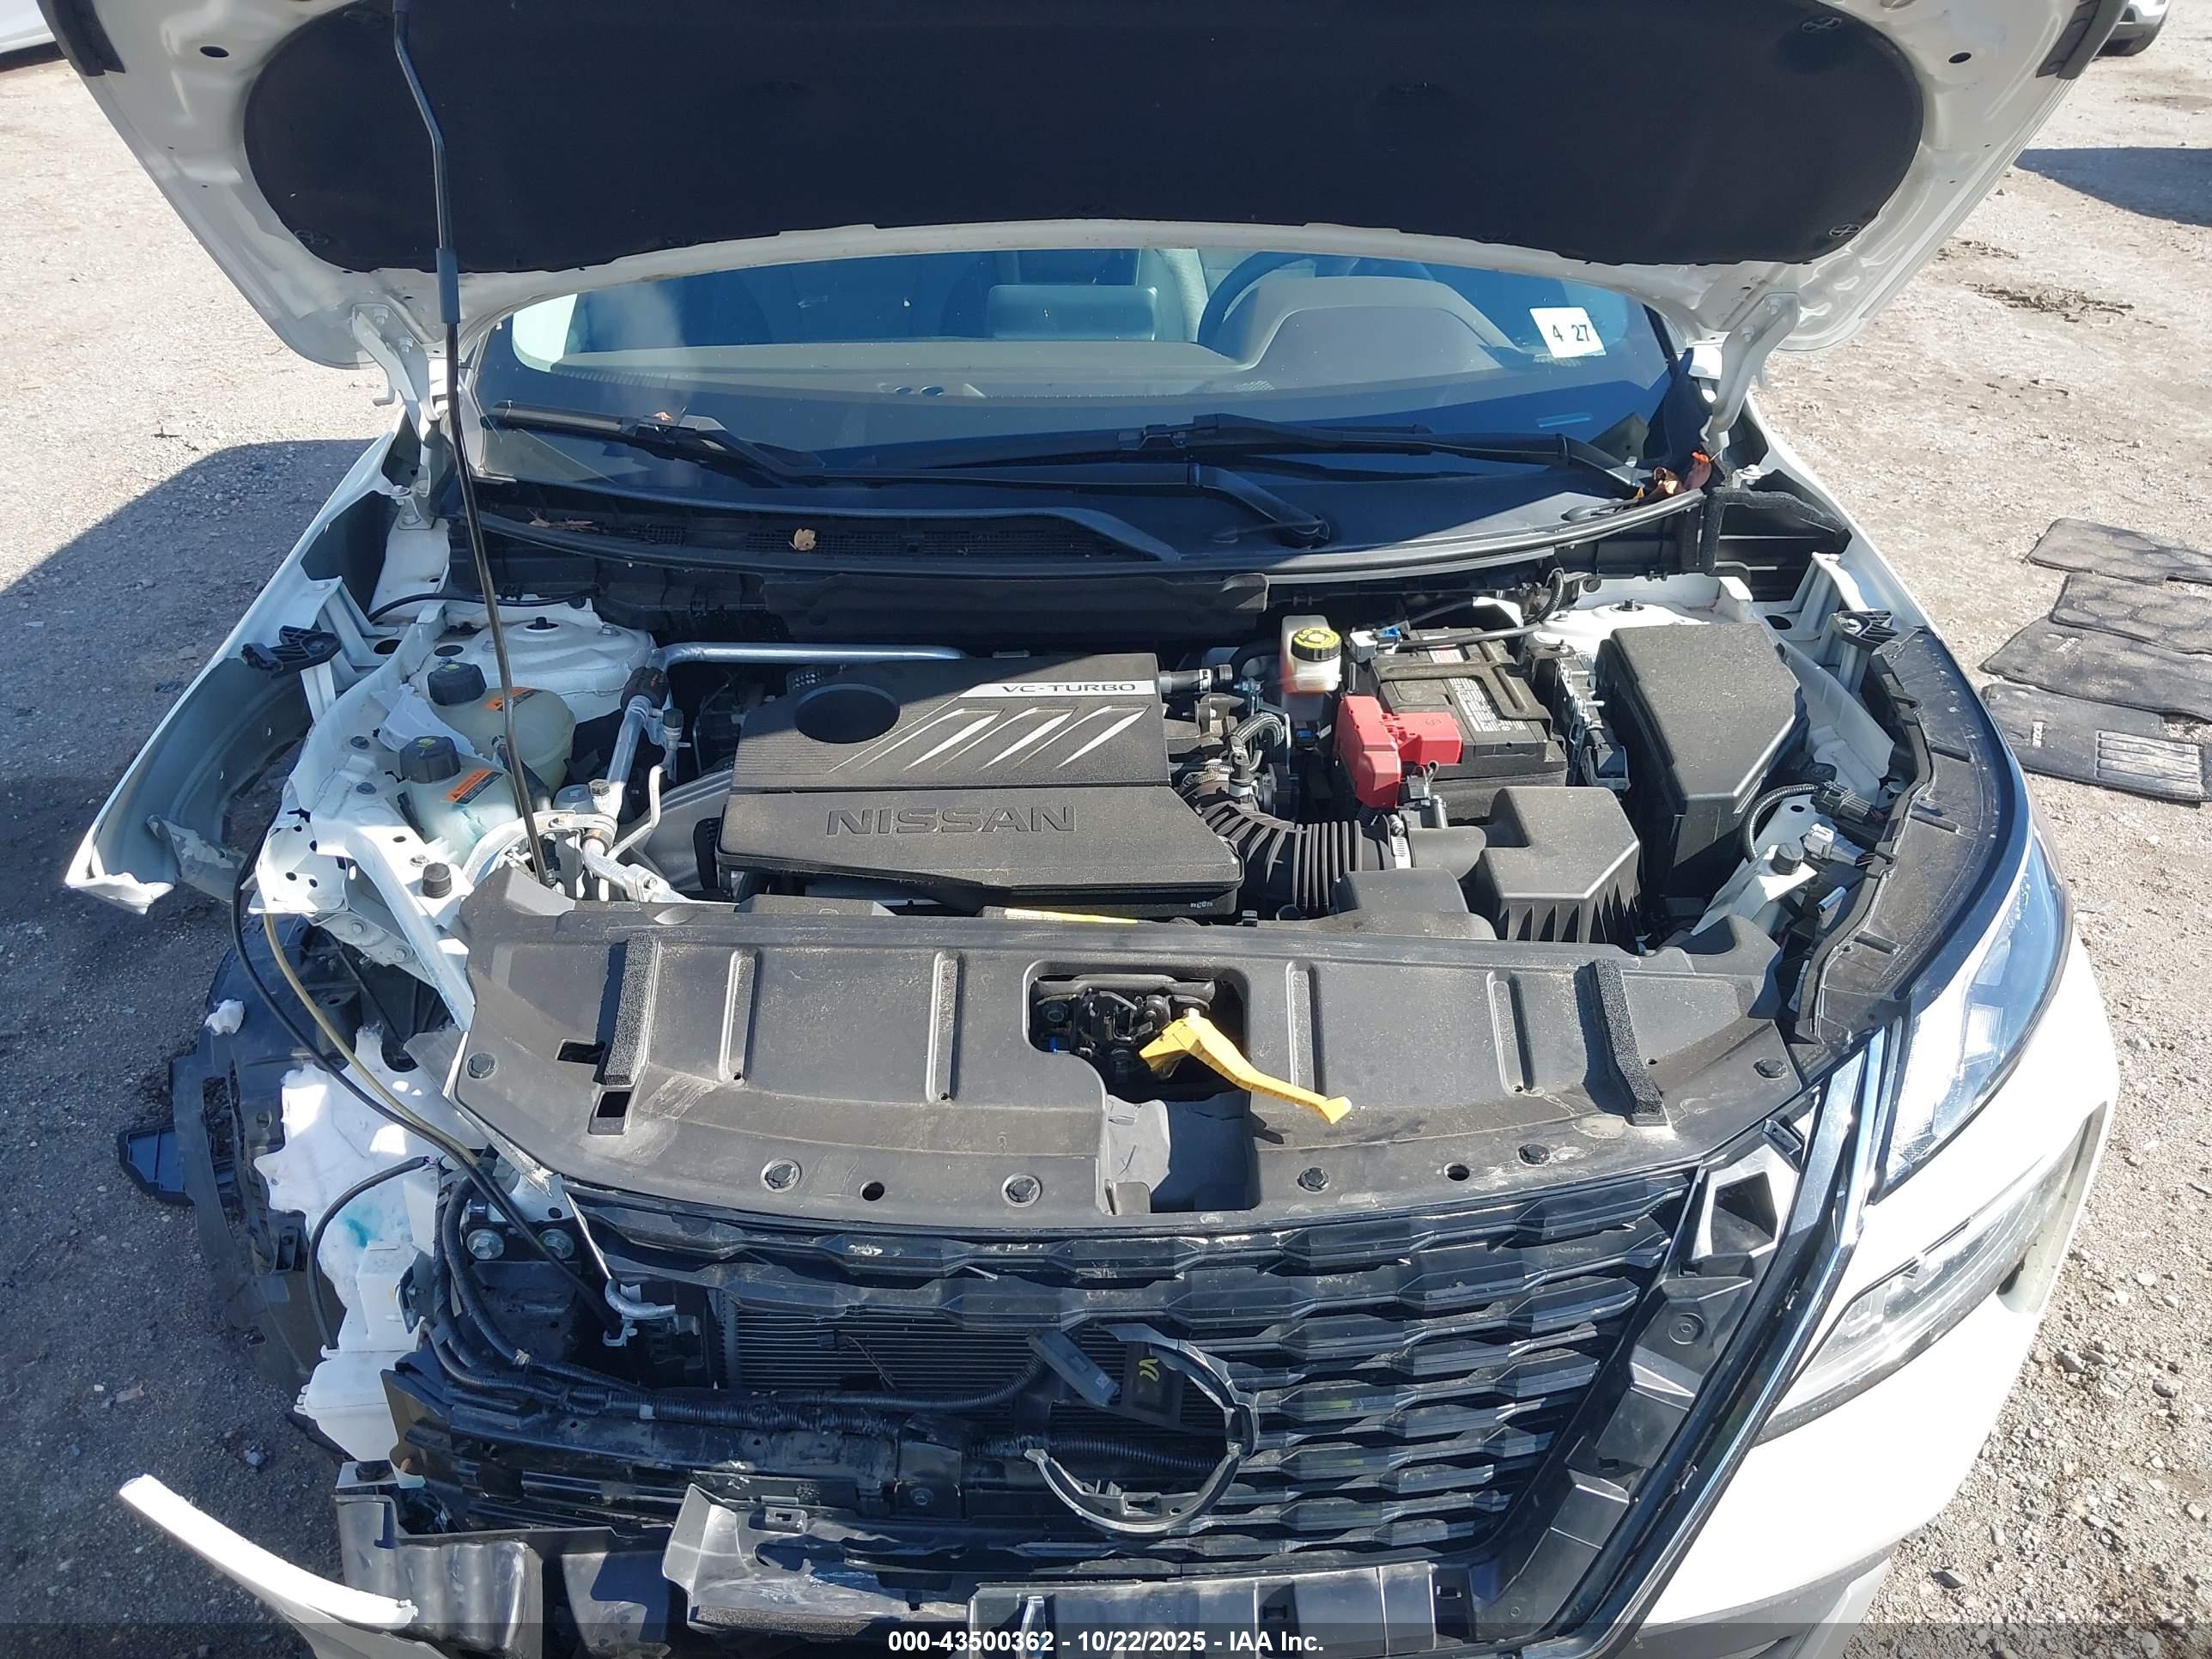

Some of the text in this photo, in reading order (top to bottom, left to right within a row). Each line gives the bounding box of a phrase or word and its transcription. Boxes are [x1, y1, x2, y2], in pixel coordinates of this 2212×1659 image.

[1553, 324, 1590, 342] 4 27
[1002, 684, 1136, 693] VC-TURBO
[826, 805, 1078, 836] NISSAN
